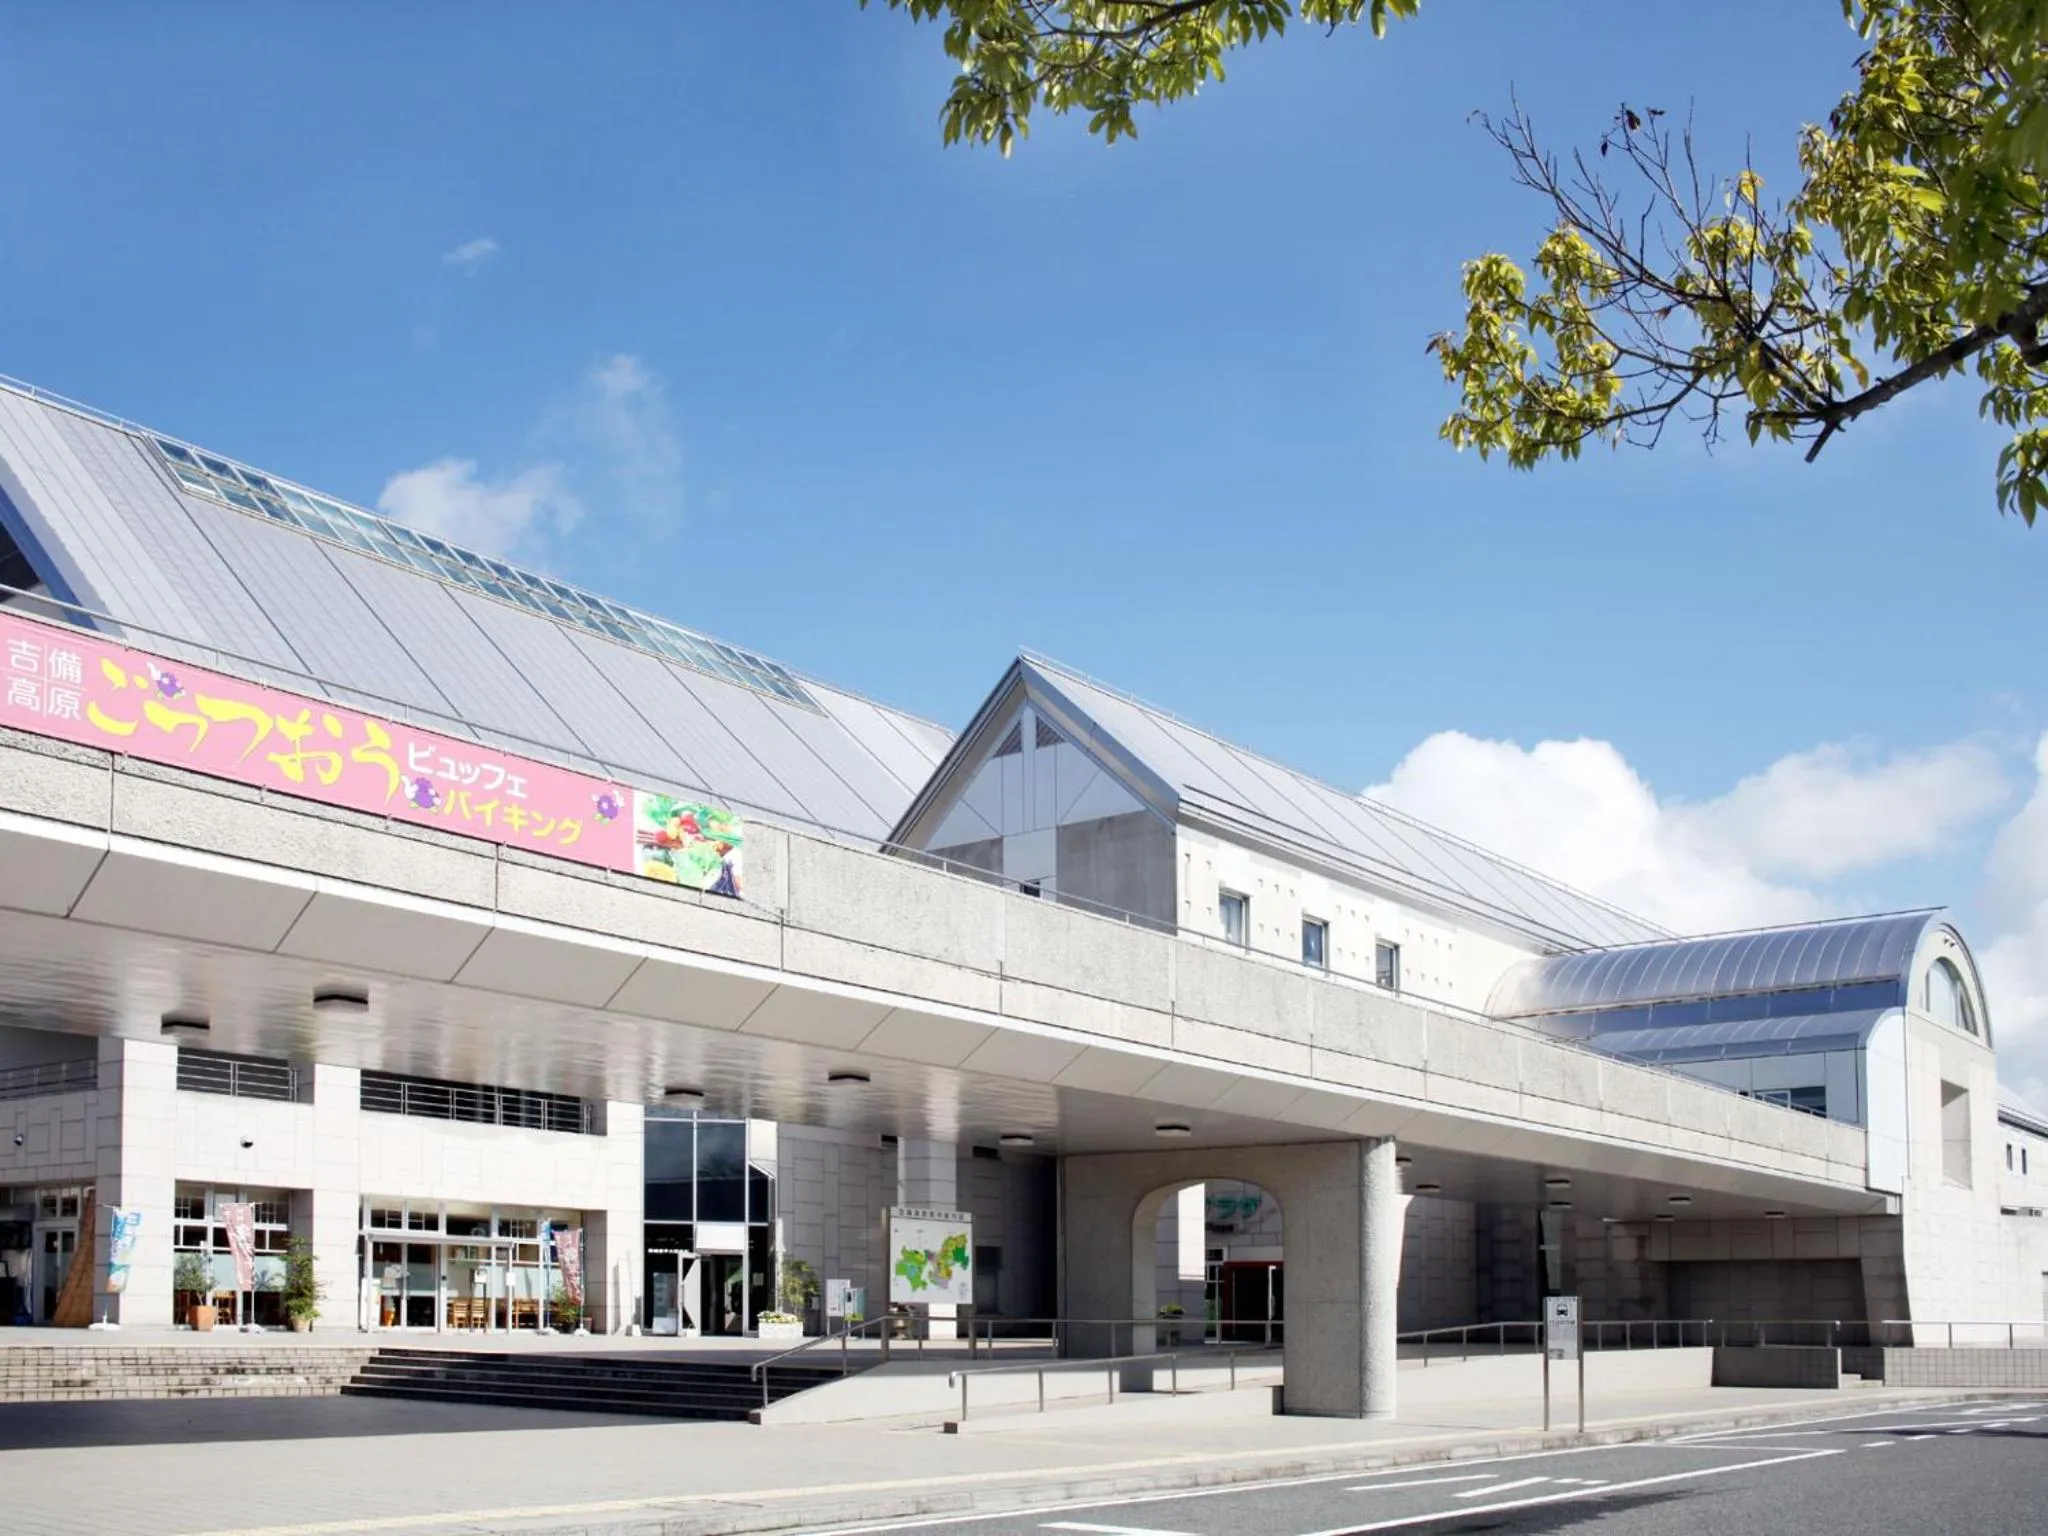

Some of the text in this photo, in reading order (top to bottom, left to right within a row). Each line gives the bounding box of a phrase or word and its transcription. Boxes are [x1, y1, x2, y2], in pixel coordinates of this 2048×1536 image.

[6, 639, 83, 685] 吉備
[7, 675, 82, 721] 高原
[408, 742, 528, 799] ビュッフェ
[444, 789, 584, 845] バイキング
